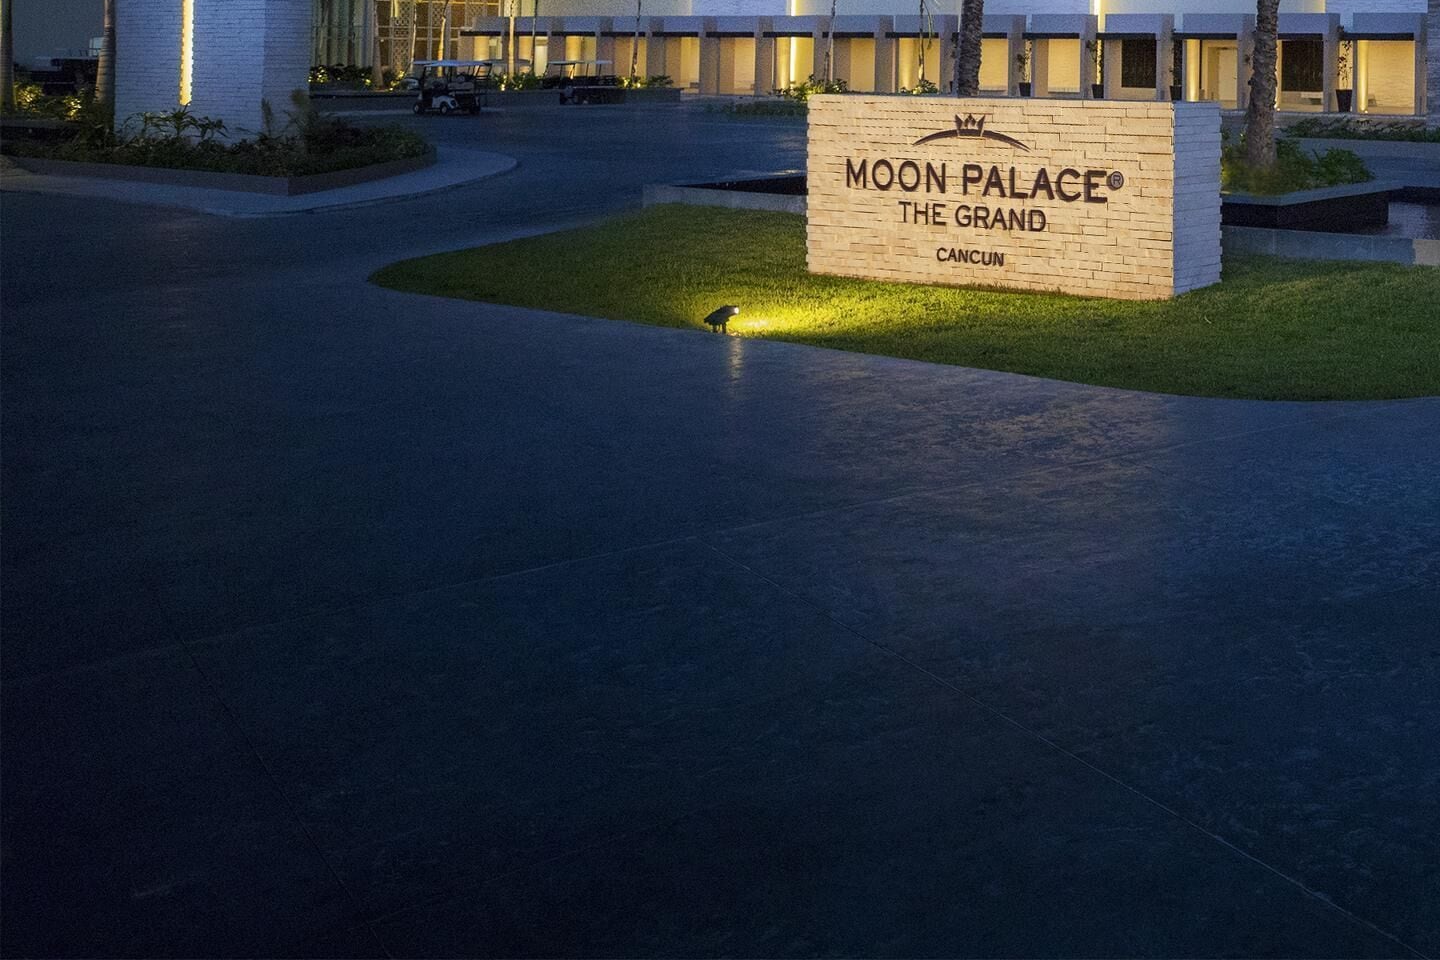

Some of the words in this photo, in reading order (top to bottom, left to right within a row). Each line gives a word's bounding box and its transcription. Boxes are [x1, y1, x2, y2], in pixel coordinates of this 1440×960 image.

[846, 158, 946, 193] MOON
[898, 200, 947, 226] THE
[954, 204, 1047, 232] GRAND
[936, 247, 1005, 267] CANCUN
